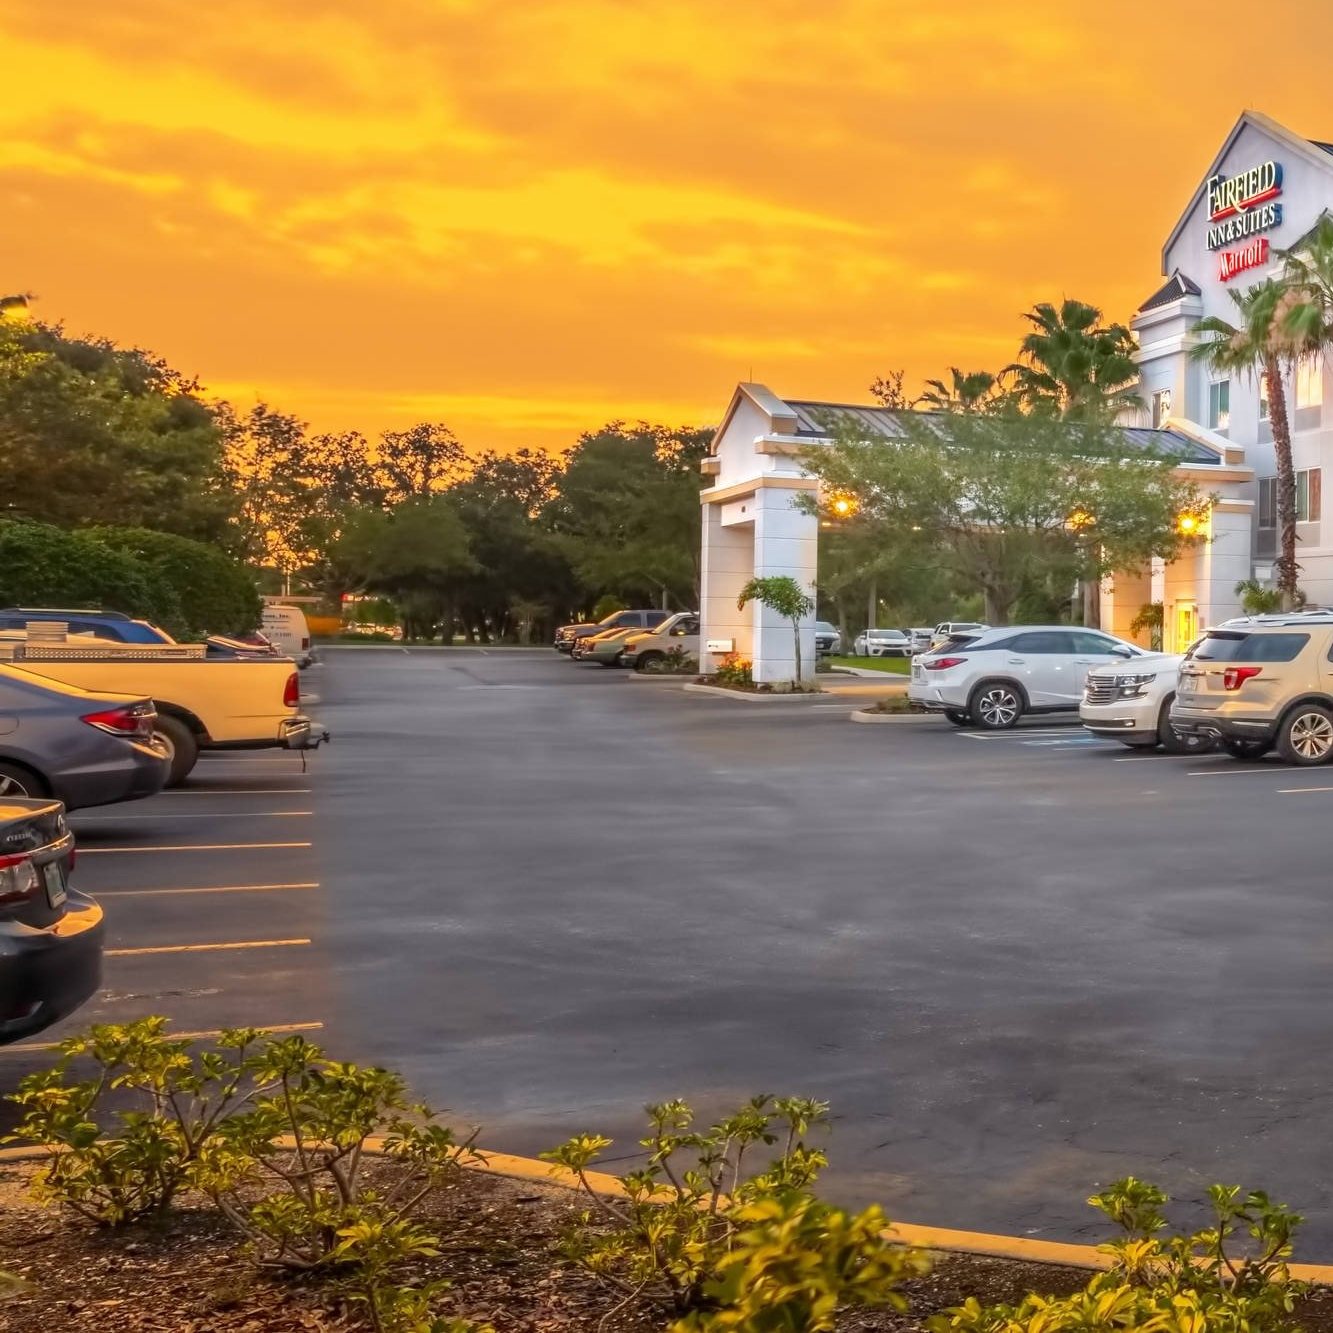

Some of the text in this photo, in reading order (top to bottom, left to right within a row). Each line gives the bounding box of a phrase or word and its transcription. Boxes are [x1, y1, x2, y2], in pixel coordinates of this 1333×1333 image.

[1206, 160, 1276, 222] FAIRFIELD
[1206, 203, 1275, 250] INN & SUITES
[1218, 239, 1262, 281] Marriott
